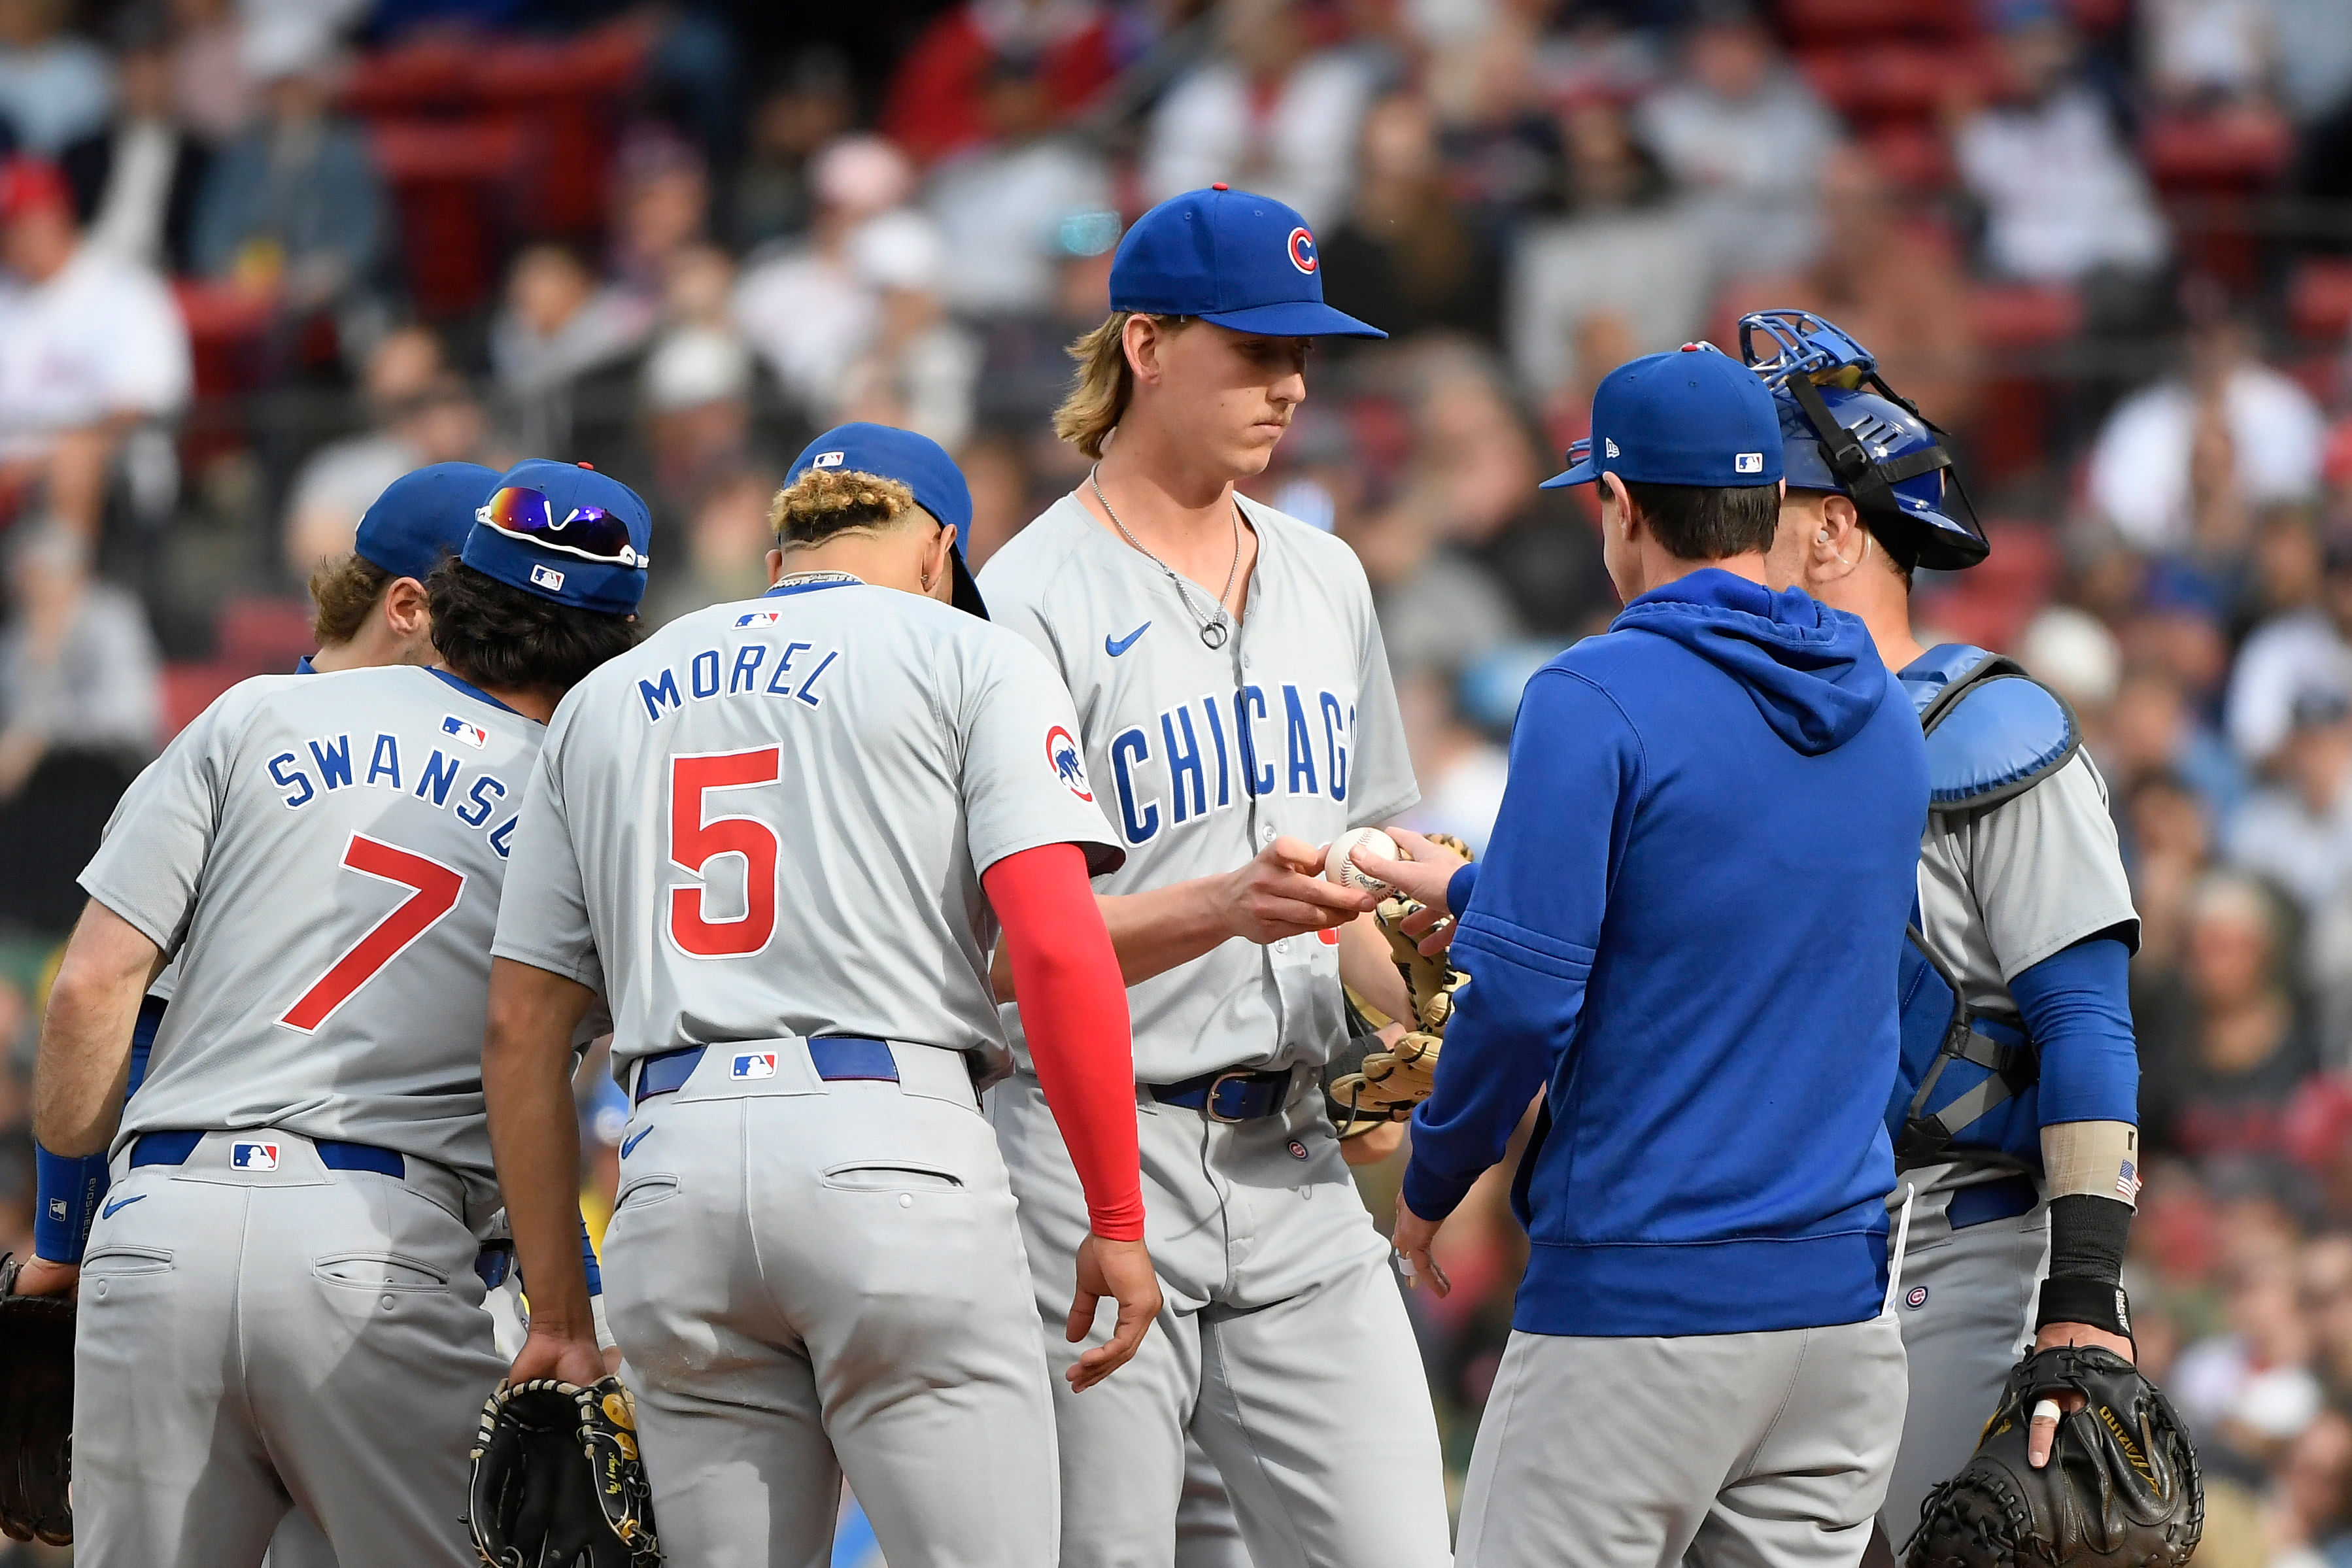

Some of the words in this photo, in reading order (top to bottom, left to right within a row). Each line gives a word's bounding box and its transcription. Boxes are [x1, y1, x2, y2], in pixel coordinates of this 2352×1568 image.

[1287, 227, 1317, 275] C
[634, 639, 842, 726] MOREL
[667, 742, 783, 960] 5
[273, 828, 468, 1036] 7
